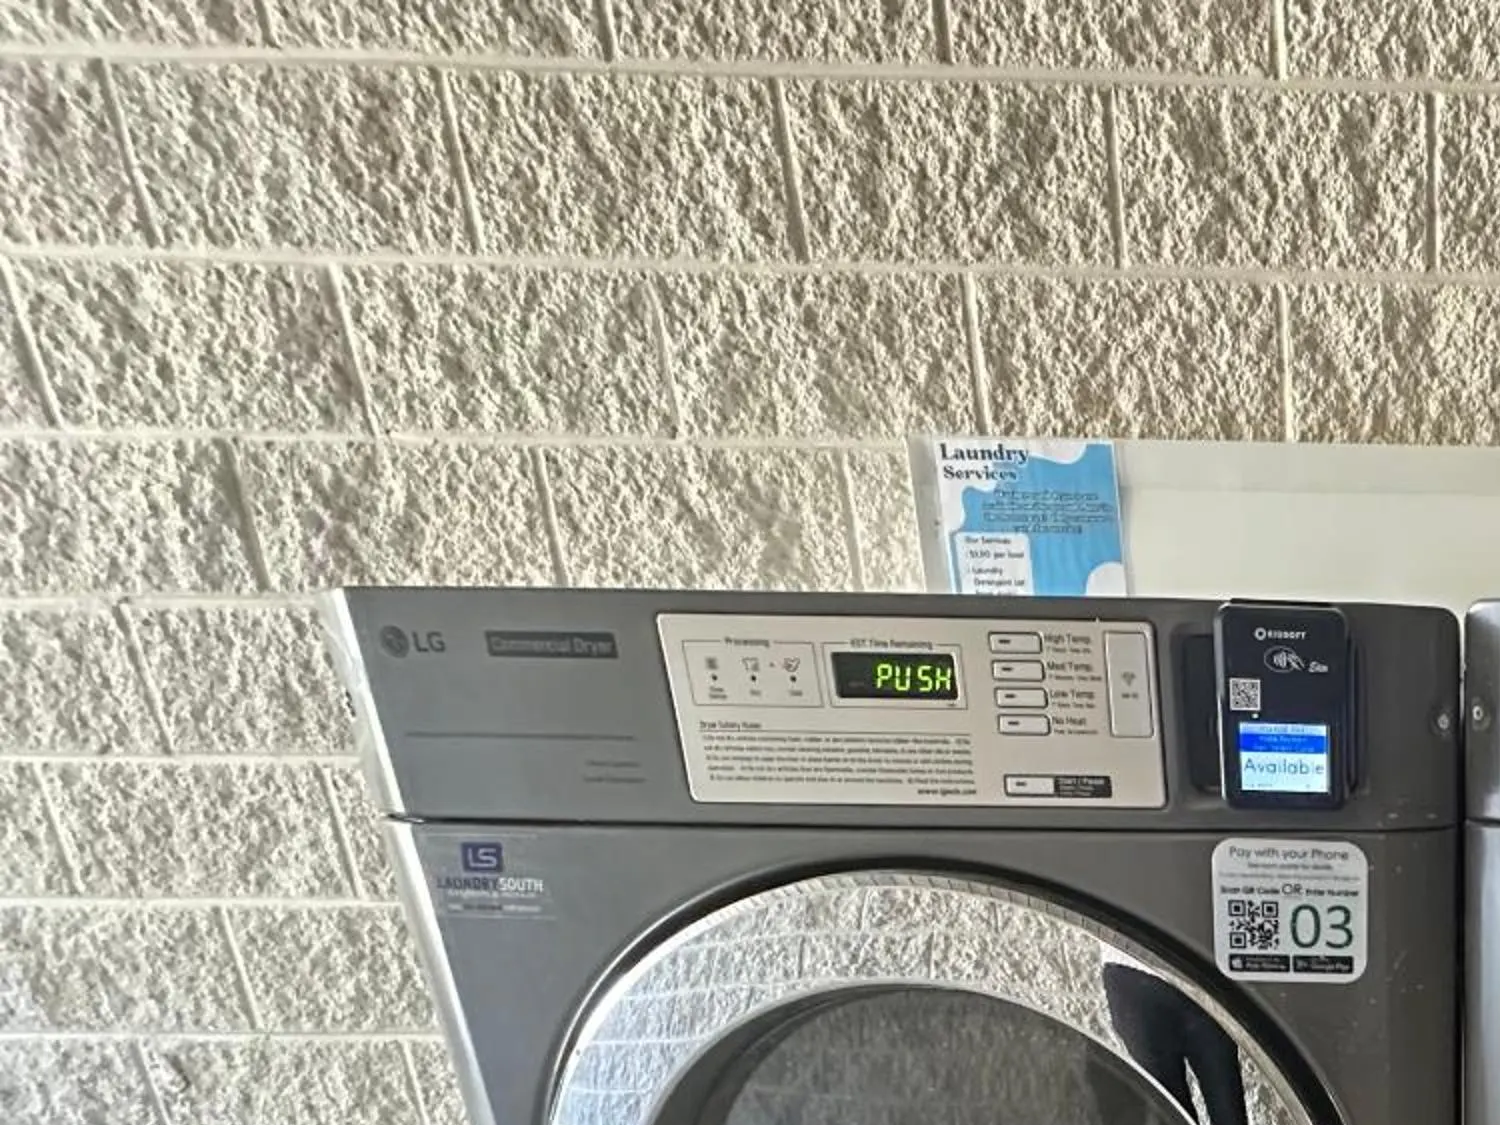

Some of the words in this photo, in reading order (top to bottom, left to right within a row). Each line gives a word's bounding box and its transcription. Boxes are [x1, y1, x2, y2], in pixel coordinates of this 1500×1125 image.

[940, 443, 1028, 465] Laundry
[943, 464, 1018, 481] Services
[412, 631, 446, 652] LG
[876, 663, 952, 692] PUSH
[1244, 757, 1325, 776] Available
[1229, 846, 1251, 860] Pay
[1254, 847, 1279, 858] with
[1281, 850, 1308, 861] your
[1311, 848, 1350, 861] Phone
[1281, 883, 1303, 896] OR
[1289, 903, 1354, 949] 03
